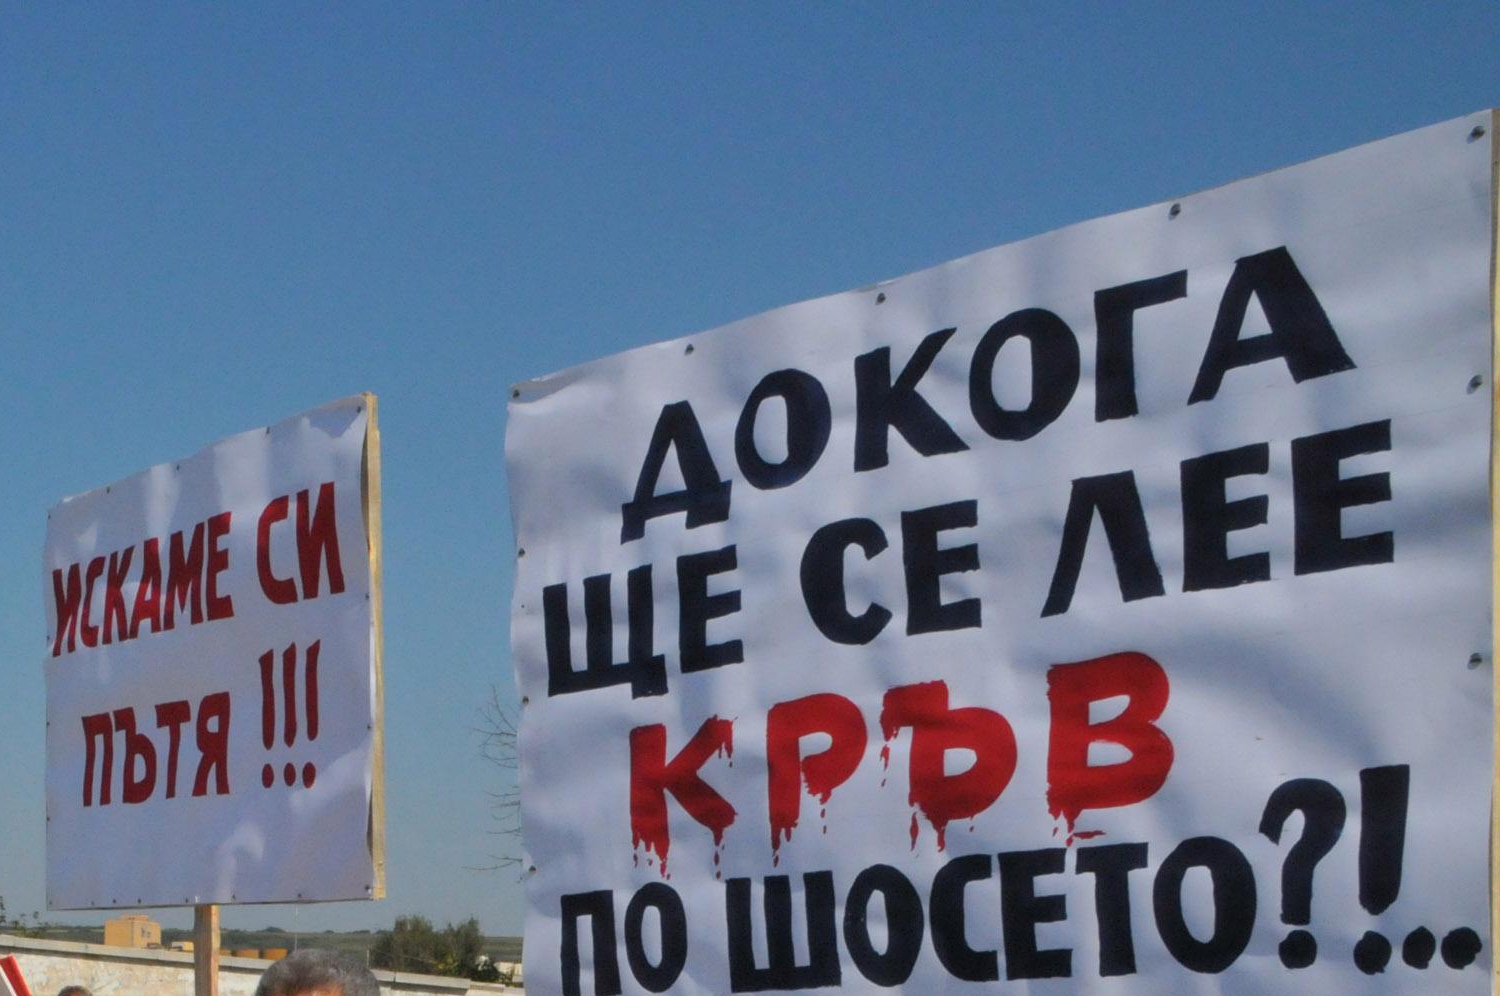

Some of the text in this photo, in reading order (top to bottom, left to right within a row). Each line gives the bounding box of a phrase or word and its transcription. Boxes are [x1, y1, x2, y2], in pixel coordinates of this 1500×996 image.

[620, 244, 1358, 546] ДОКОГА
[52, 480, 346, 658] ИСКАМЕ СИ
[542, 418, 1395, 701] ЩЕ СЕ ЛЕЕ
[81, 691, 232, 807] ПЪТЯ
[630, 651, 1175, 872] КРЪВ
